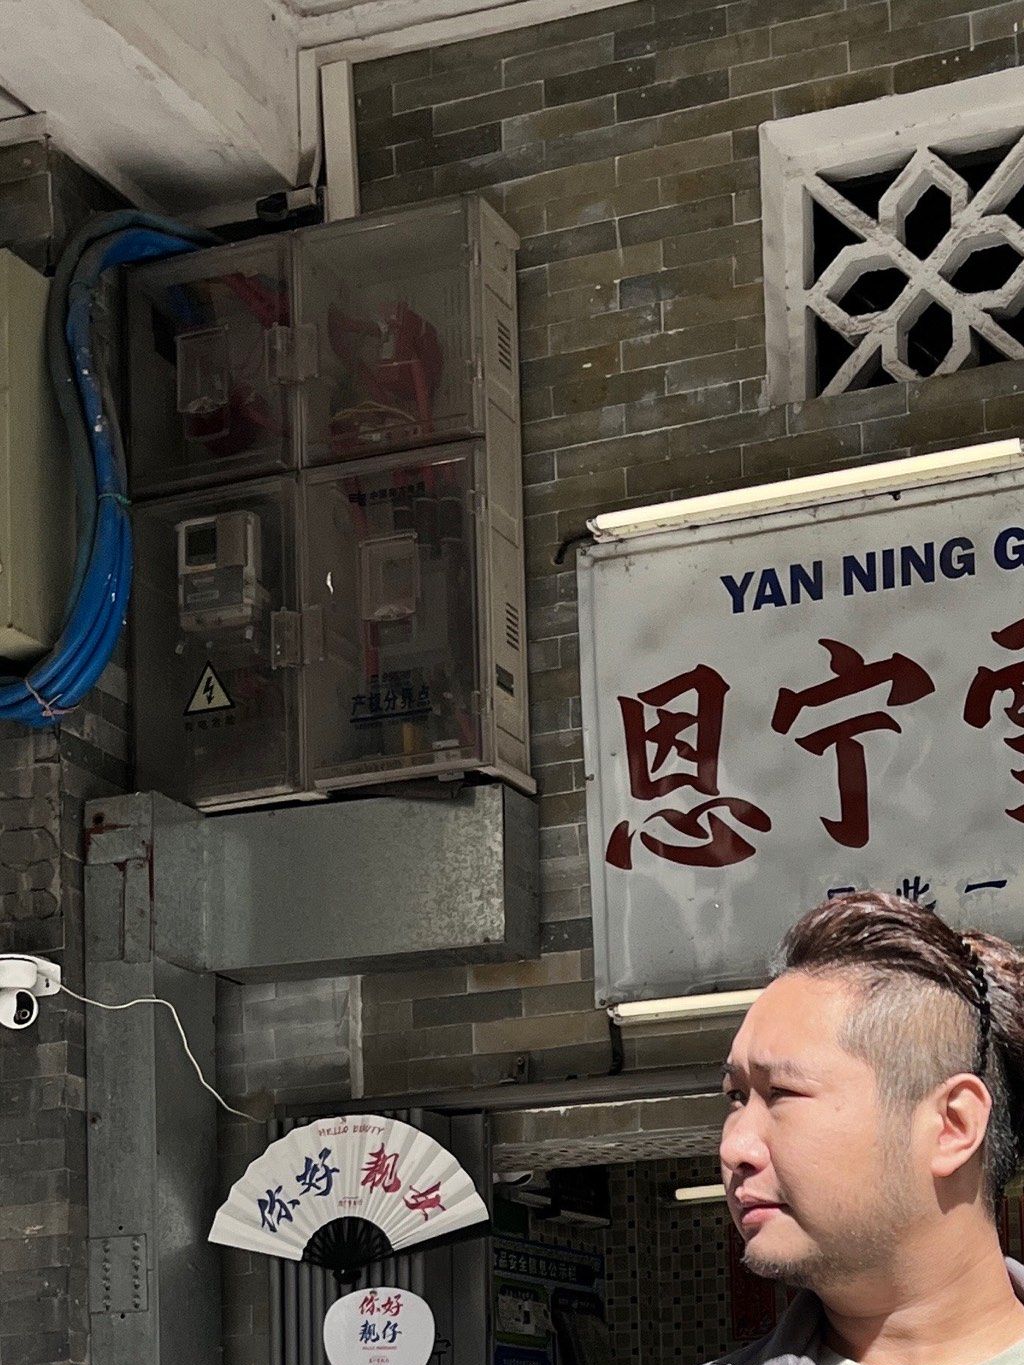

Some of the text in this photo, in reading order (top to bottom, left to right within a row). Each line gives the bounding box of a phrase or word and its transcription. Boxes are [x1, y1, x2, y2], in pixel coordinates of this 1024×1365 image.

[720, 560, 823, 613] YAN
[843, 537, 976, 596] NING
[319, 1125, 348, 1136] HELLO
[258, 1147, 340, 1232] 你好
[359, 1294, 403, 1316] 你好
[359, 1320, 402, 1344] 靓仔
